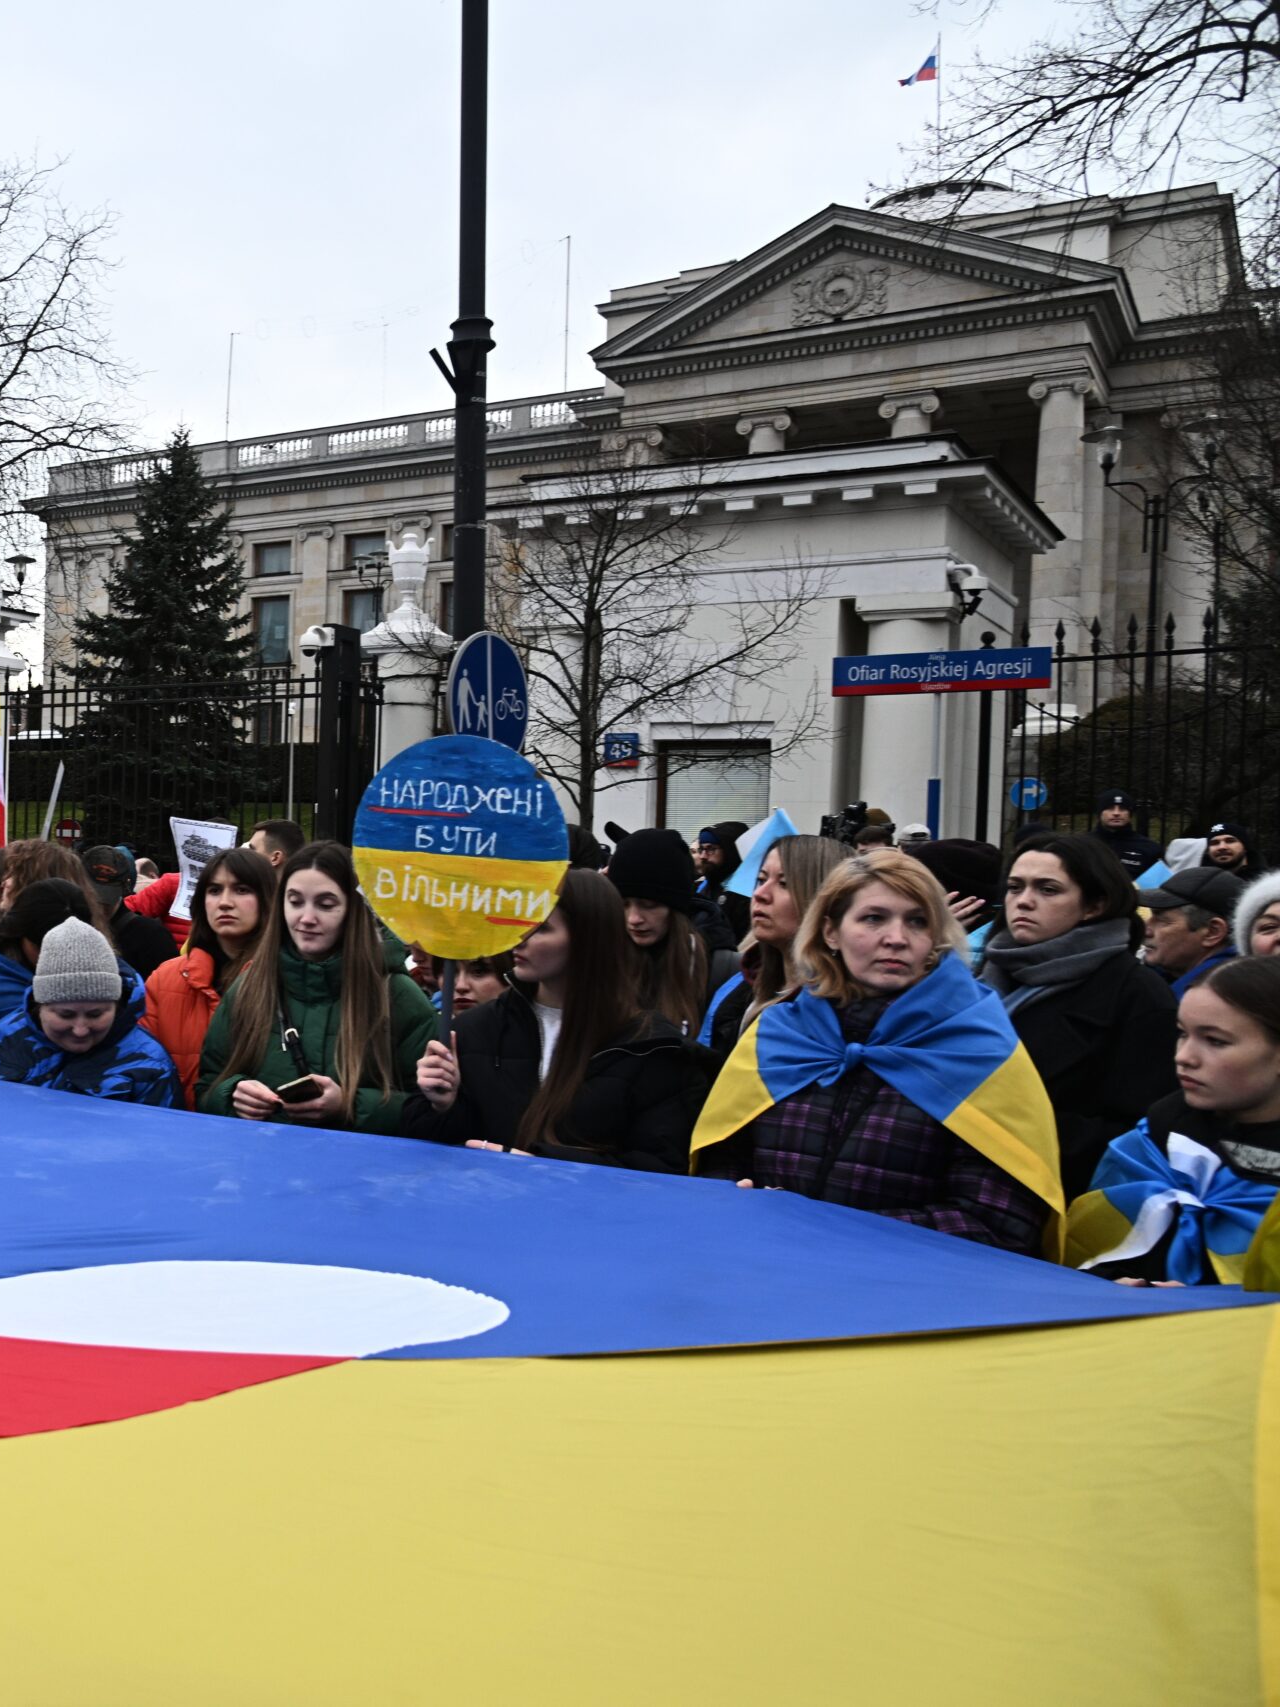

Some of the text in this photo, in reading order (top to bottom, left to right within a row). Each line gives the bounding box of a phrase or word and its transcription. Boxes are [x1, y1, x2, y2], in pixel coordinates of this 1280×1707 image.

[848, 657, 1032, 682] Ofiar Rosyjskiej Agresji
[415, 825, 497, 855] БУТИ
